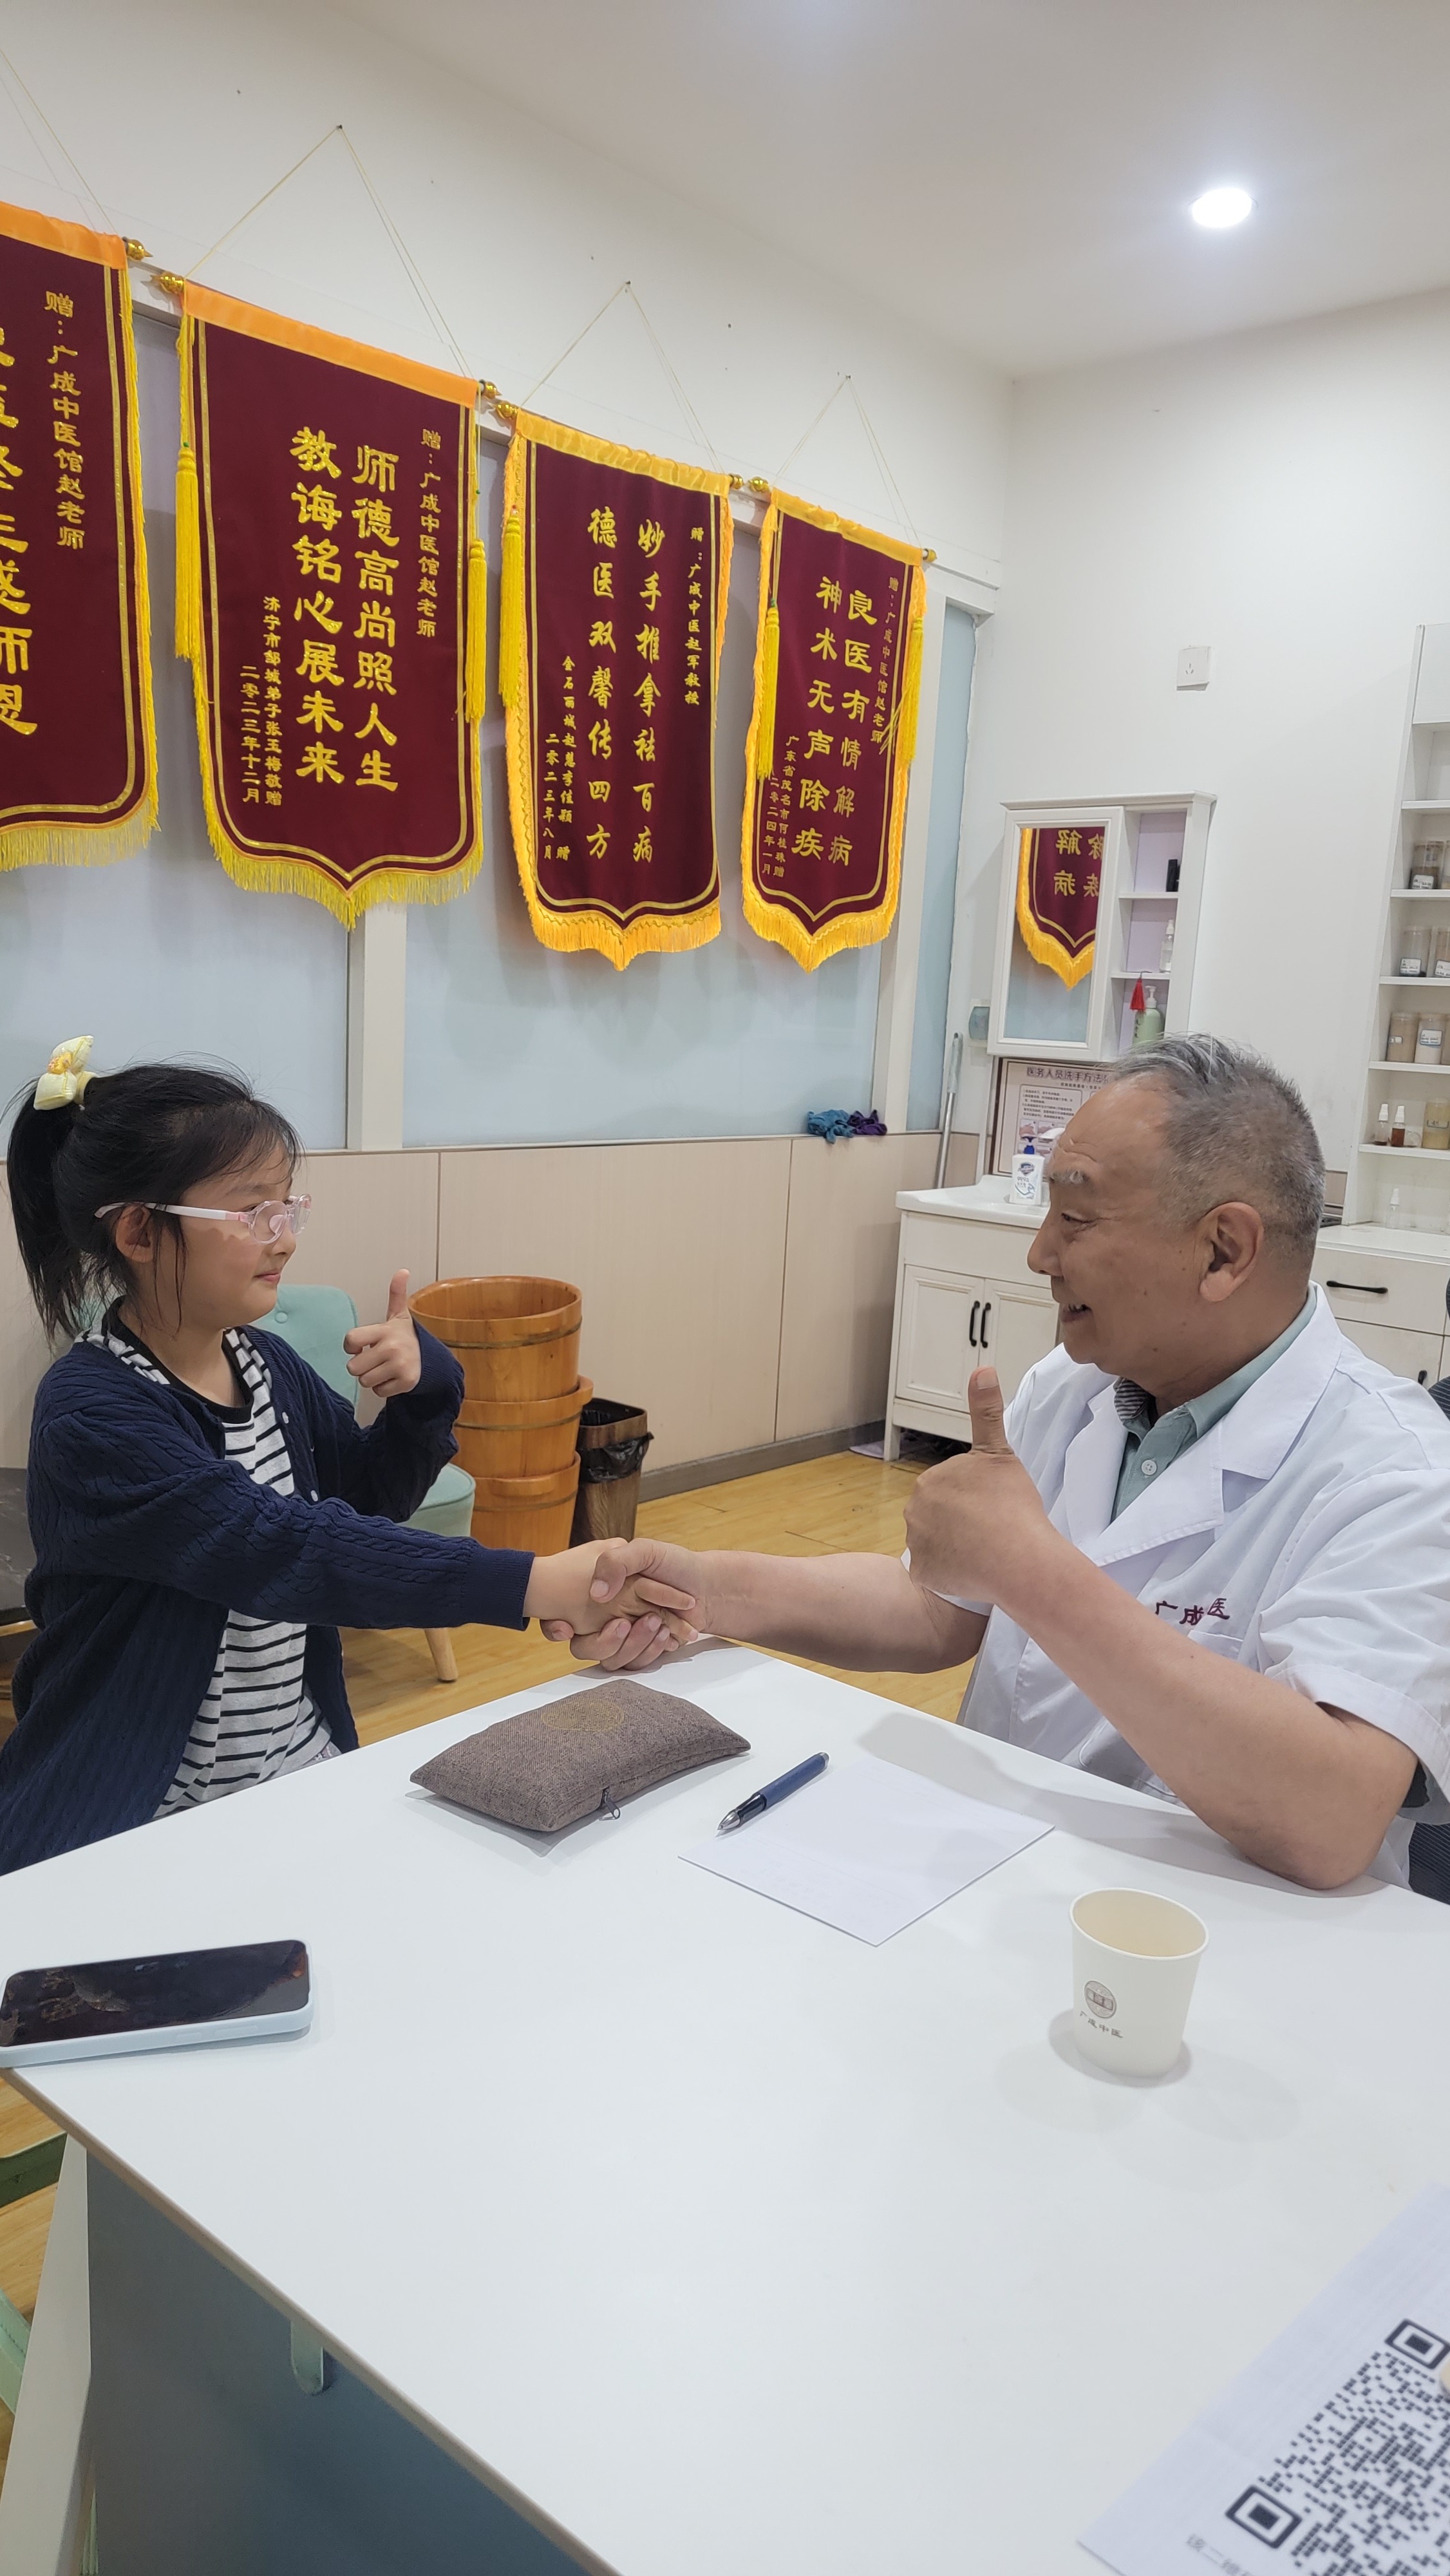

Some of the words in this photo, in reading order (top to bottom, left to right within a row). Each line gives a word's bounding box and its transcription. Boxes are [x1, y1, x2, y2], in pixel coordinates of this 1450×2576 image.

[44, 290, 85, 550] 赠：广成中医馆赵老师
[416, 429, 442, 638] 赠：广成中医馆赵老师
[263, 596, 283, 806] 济宁市邹城弟子张玉梅敬赠
[290, 426, 345, 784] 教诲铭心展未来
[352, 444, 399, 792] 师德高尚照人生
[587, 506, 618, 859] 德医双馨传四方
[632, 518, 666, 862] 妙手推拿祛百病
[684, 527, 704, 706] 赠：广成中医赵军教授
[791, 576, 843, 859] 神术无声除疾
[240, 665, 260, 804] 二零二三年十二月
[543, 733, 560, 860] 二零二三年八月
[762, 777, 780, 875] 二零二四年一月
[773, 735, 800, 877] 广东省茂名市何桂珠赠
[828, 589, 878, 866] 良医有情解病
